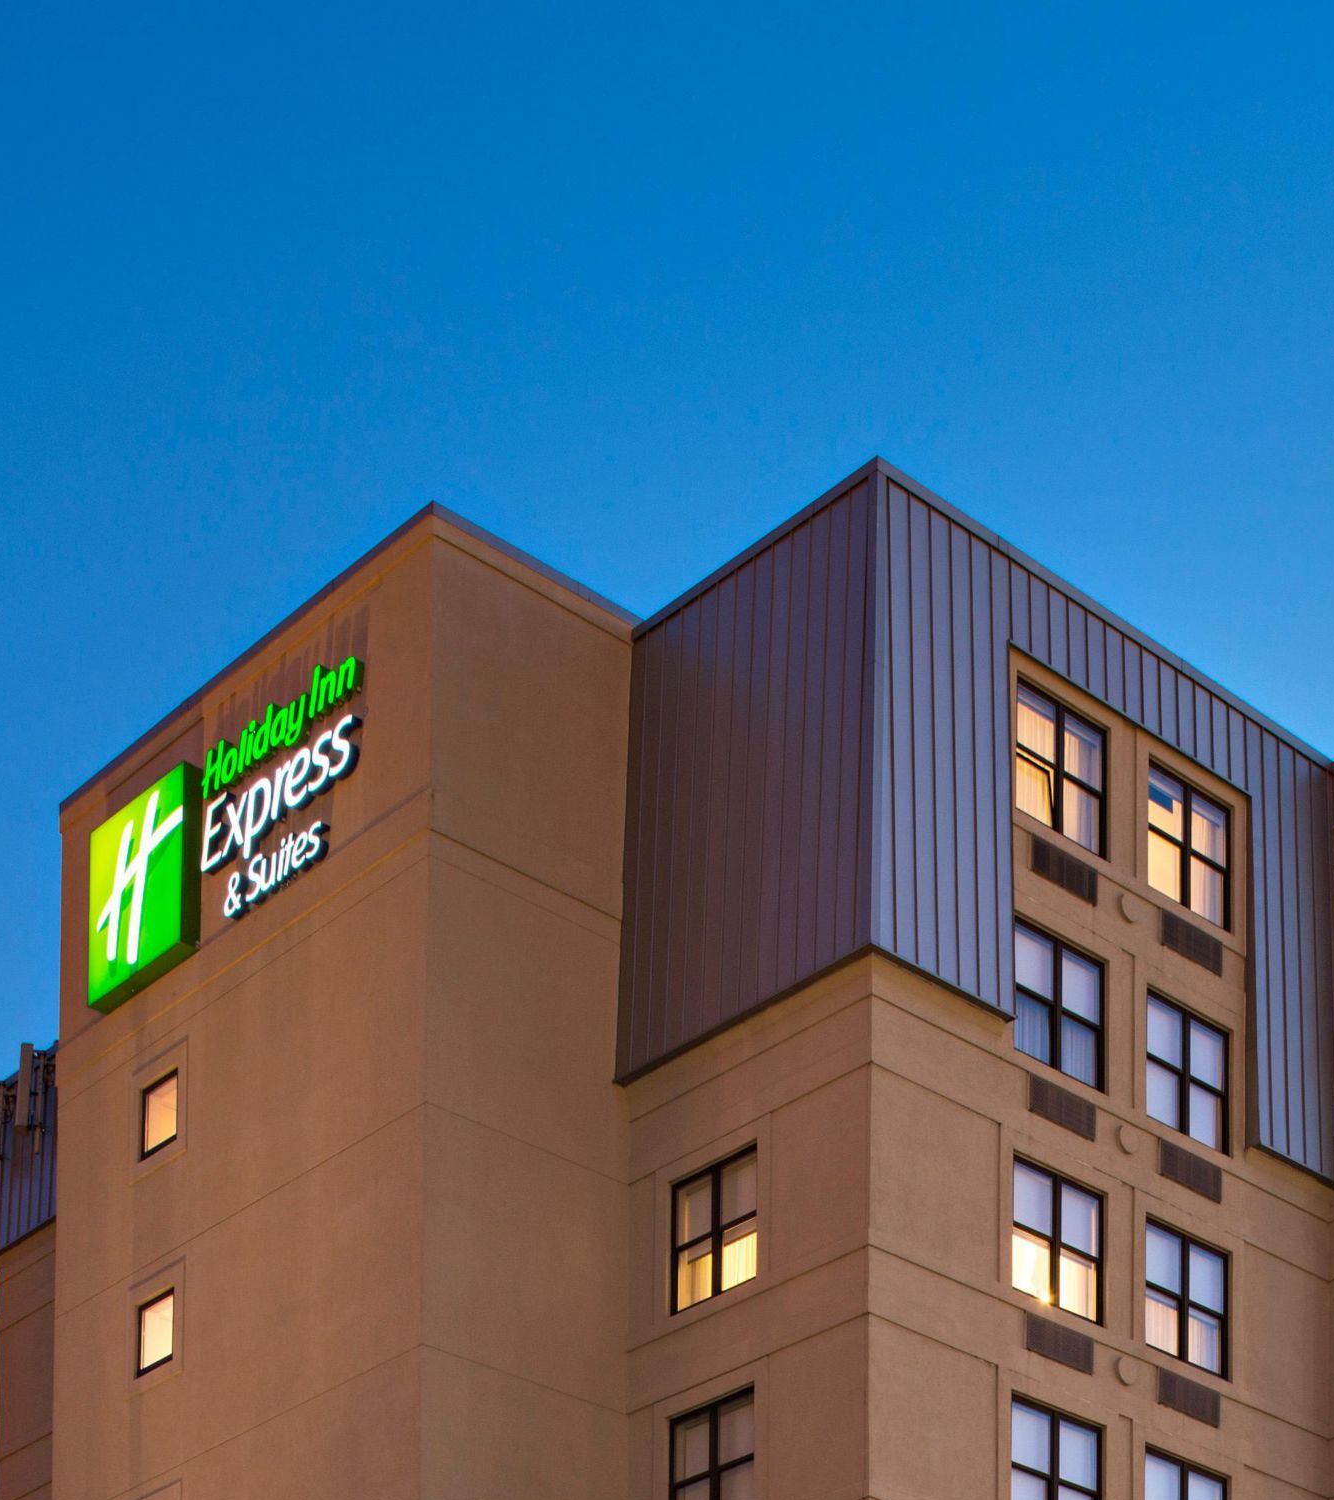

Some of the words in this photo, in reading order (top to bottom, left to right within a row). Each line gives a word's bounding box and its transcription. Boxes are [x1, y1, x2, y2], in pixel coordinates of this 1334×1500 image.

[201, 714, 353, 872] Express
[202, 693, 307, 798] Holiday
[308, 656, 355, 718] Inn
[224, 872, 242, 917] &
[246, 821, 322, 902] Suites
